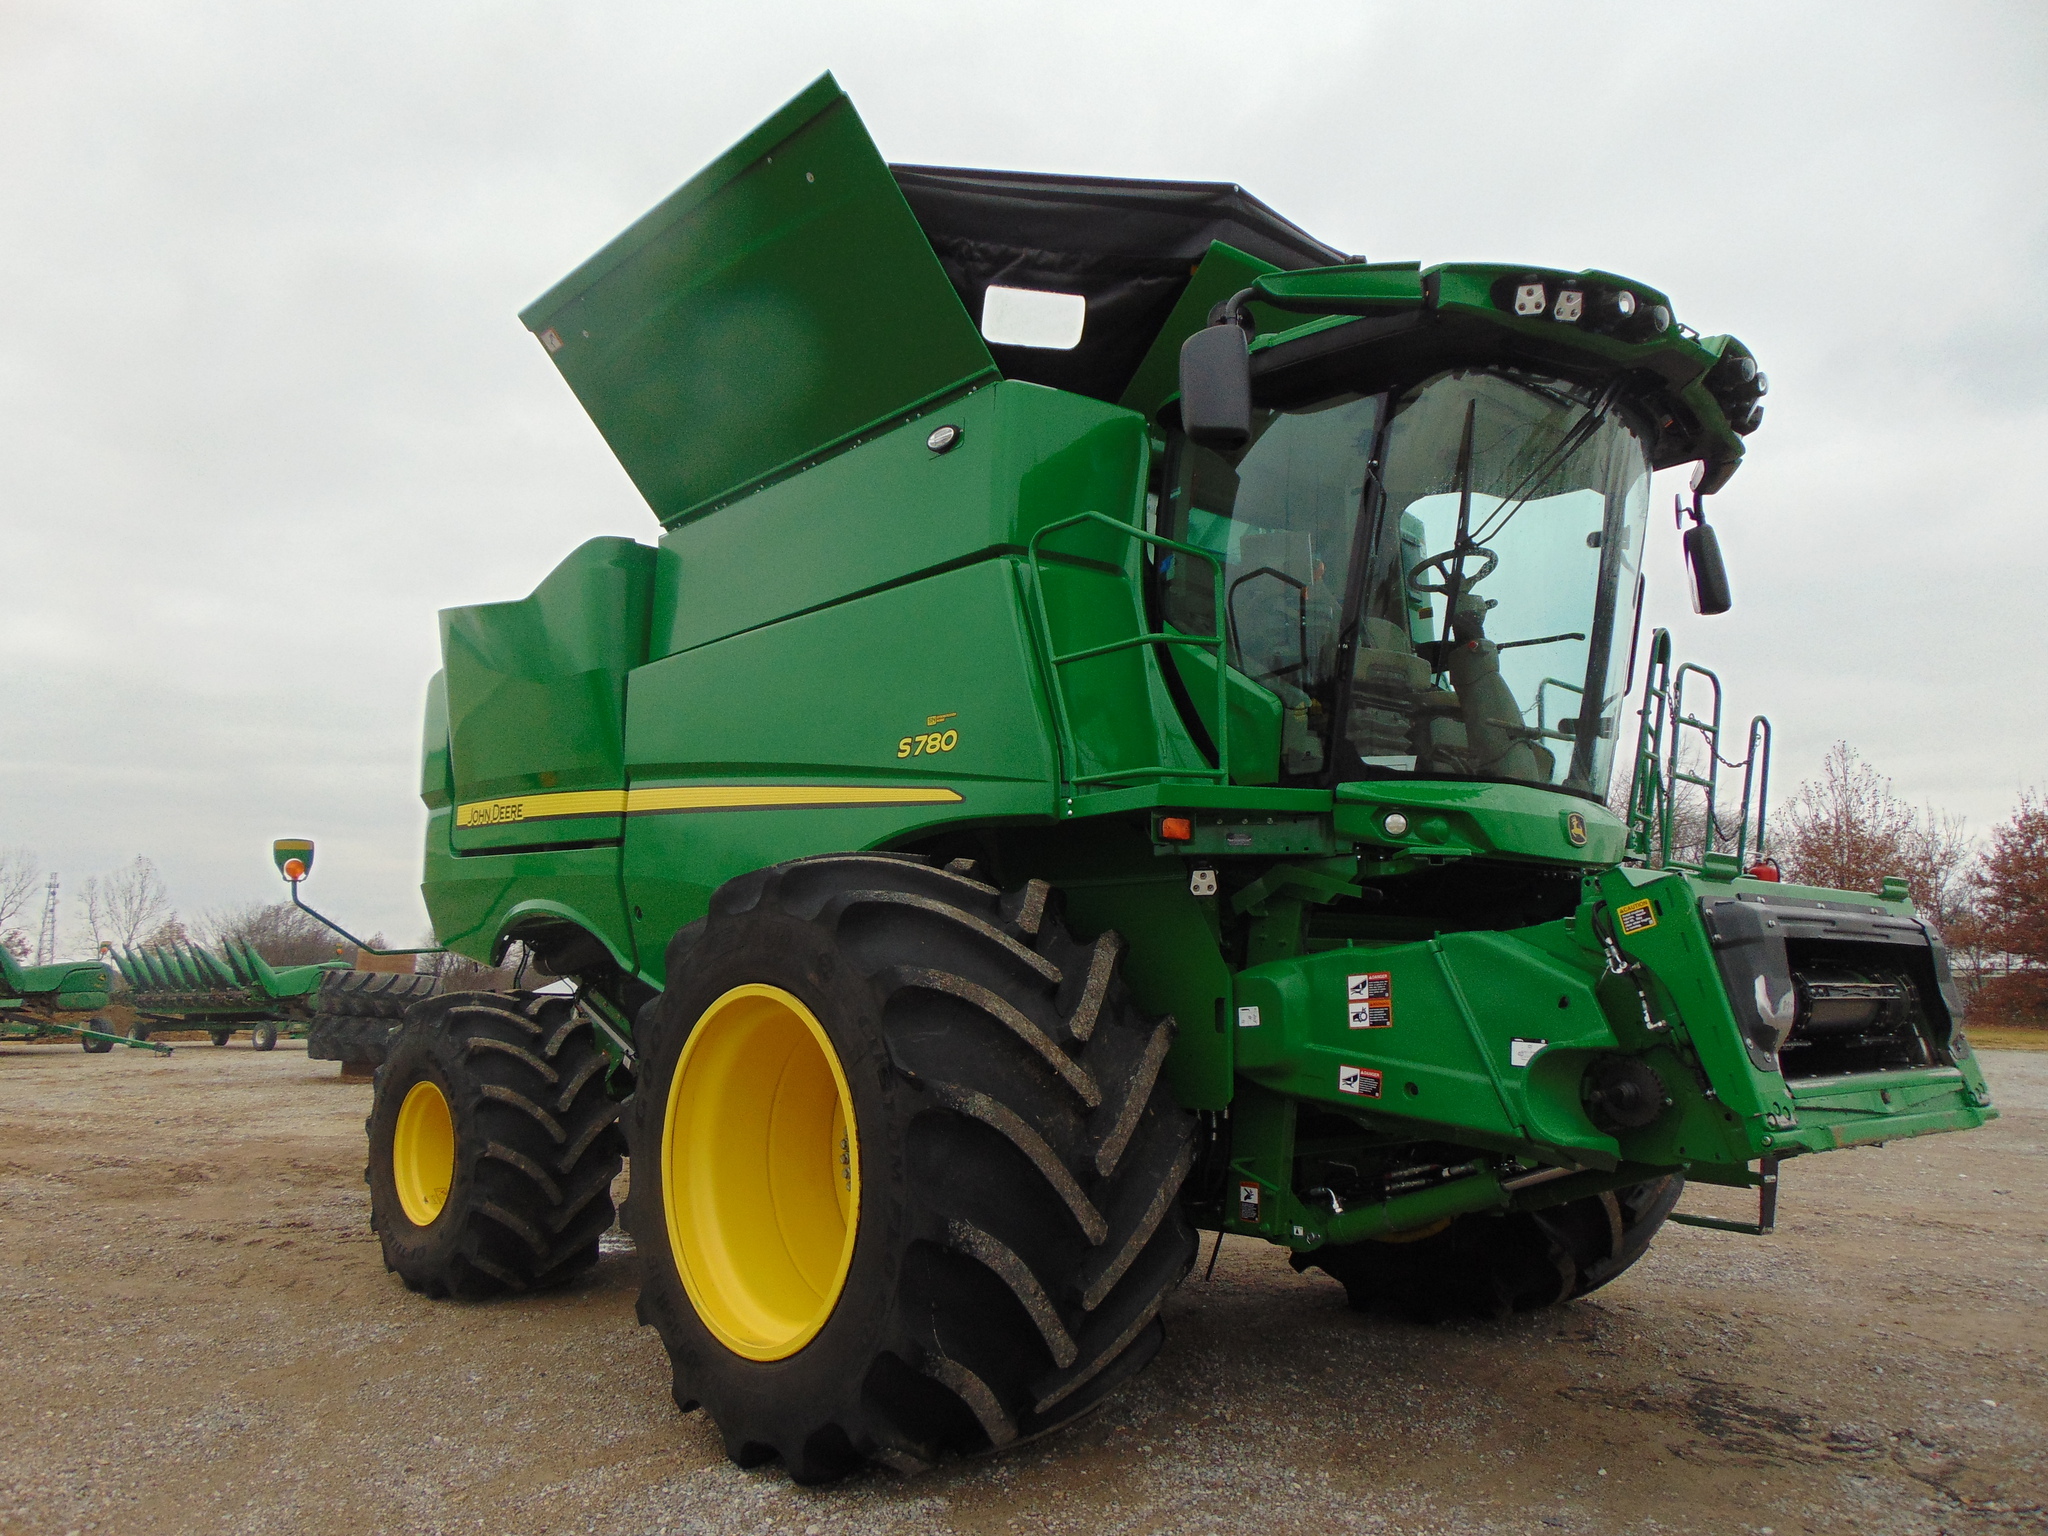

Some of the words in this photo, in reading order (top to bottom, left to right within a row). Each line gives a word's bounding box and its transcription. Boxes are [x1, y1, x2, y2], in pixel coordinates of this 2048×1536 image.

[897, 728, 958, 759] S780
[467, 807, 492, 825] JOHN
[492, 803, 523, 821] DEERE
[1623, 900, 1648, 912] CAUTION
